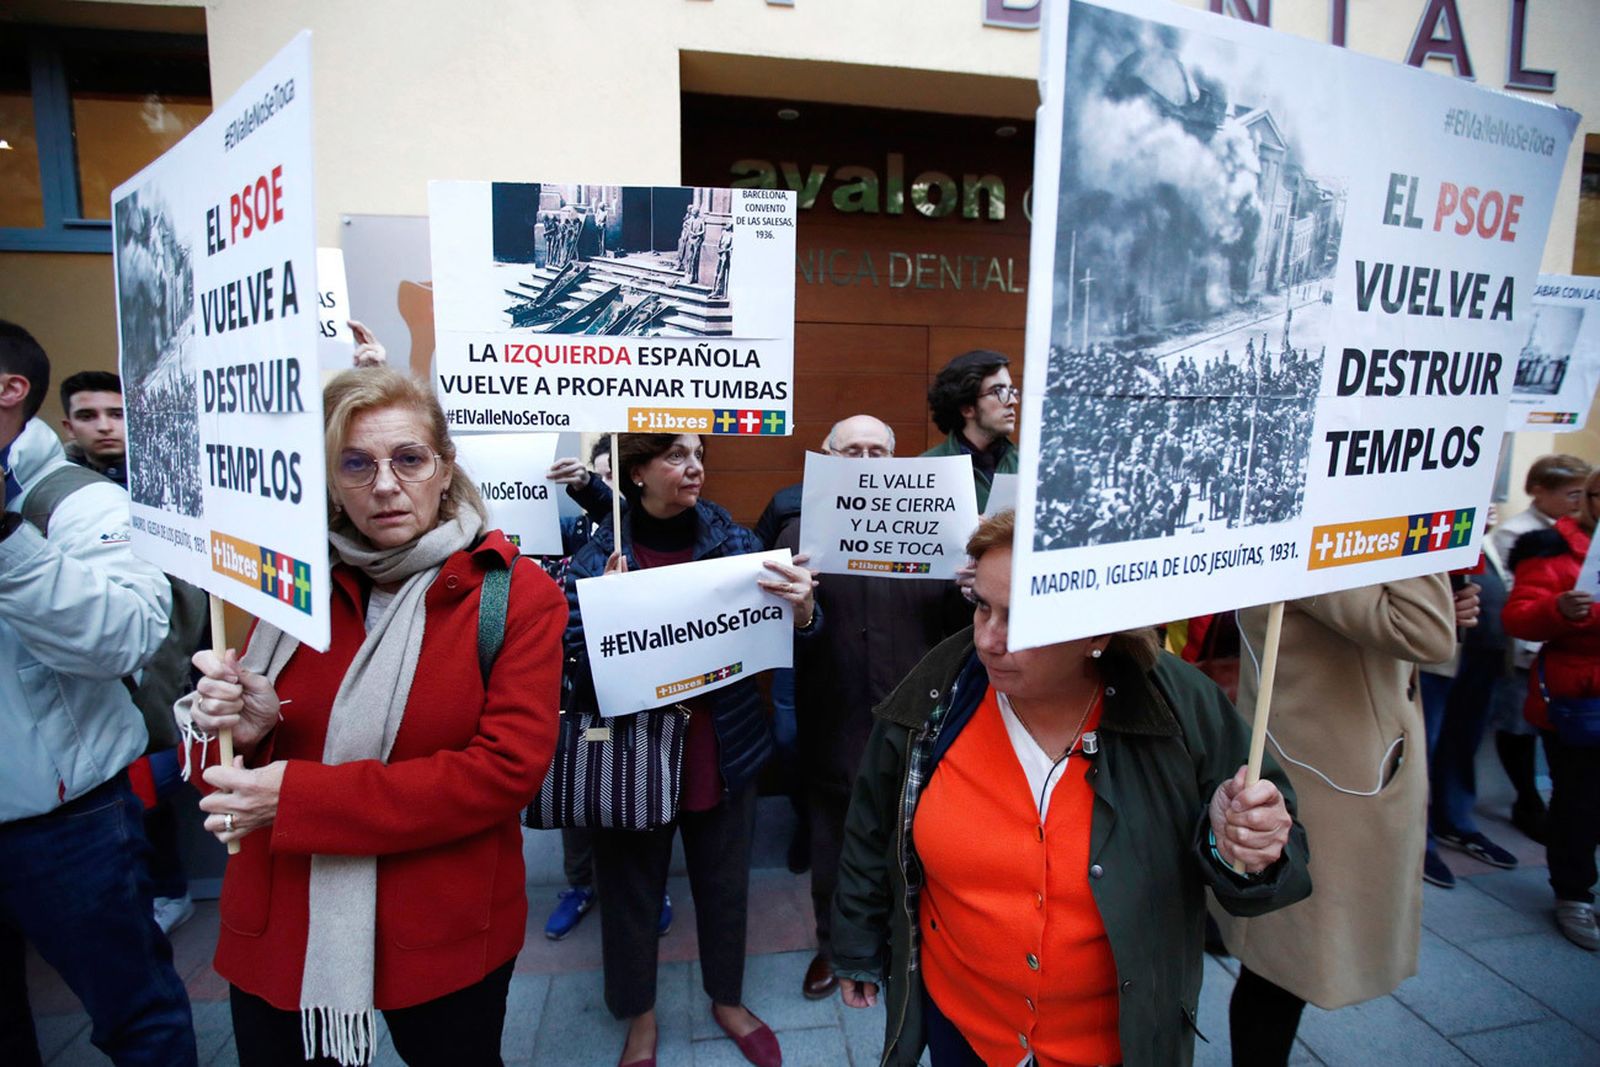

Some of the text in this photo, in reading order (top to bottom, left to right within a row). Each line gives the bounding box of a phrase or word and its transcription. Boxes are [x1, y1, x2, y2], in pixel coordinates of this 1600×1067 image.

[224, 78, 295, 152] #ElValleNoSeToca
[1445, 107, 1556, 156] #ElValleNoSeToca
[730, 153, 1006, 220] avalon
[742, 190, 788, 200] BARCELONA,
[745, 203, 786, 213] CONVENTO
[1383, 173, 1524, 242] EL PSOE
[206, 164, 284, 257] EL PSOE
[736, 216, 794, 228] DE LAS SALESAS,
[756, 230, 775, 240] 1936.
[889, 252, 1025, 293] DENTAL
[1355, 260, 1514, 321] VUELVE A
[1533, 285, 1561, 297] ABAR
[201, 260, 299, 337] VUELVE A
[468, 343, 761, 369] LA IZQUIERDA ESPAÑOLA
[1336, 347, 1503, 397] DESTRUIR
[203, 357, 305, 414] DESTRUIR
[440, 374, 788, 400] VUELVE A PROFANAR TUMBAS
[446, 408, 571, 427] #ElValleNoSeToca
[1325, 424, 1485, 478] TEMPLOS
[206, 443, 302, 505] TEMPLOS
[858, 473, 936, 489] EL VALLE
[836, 496, 956, 513] NO SE CIERRA
[850, 519, 939, 535] Y LA CRUZ
[839, 539, 944, 556] NO SE TOCA
[1030, 541, 1299, 597] MADRID, IGLESIA DE LOS JESUÍTAS, 1931.
[600, 605, 783, 658] #ElValleNoSeToca
